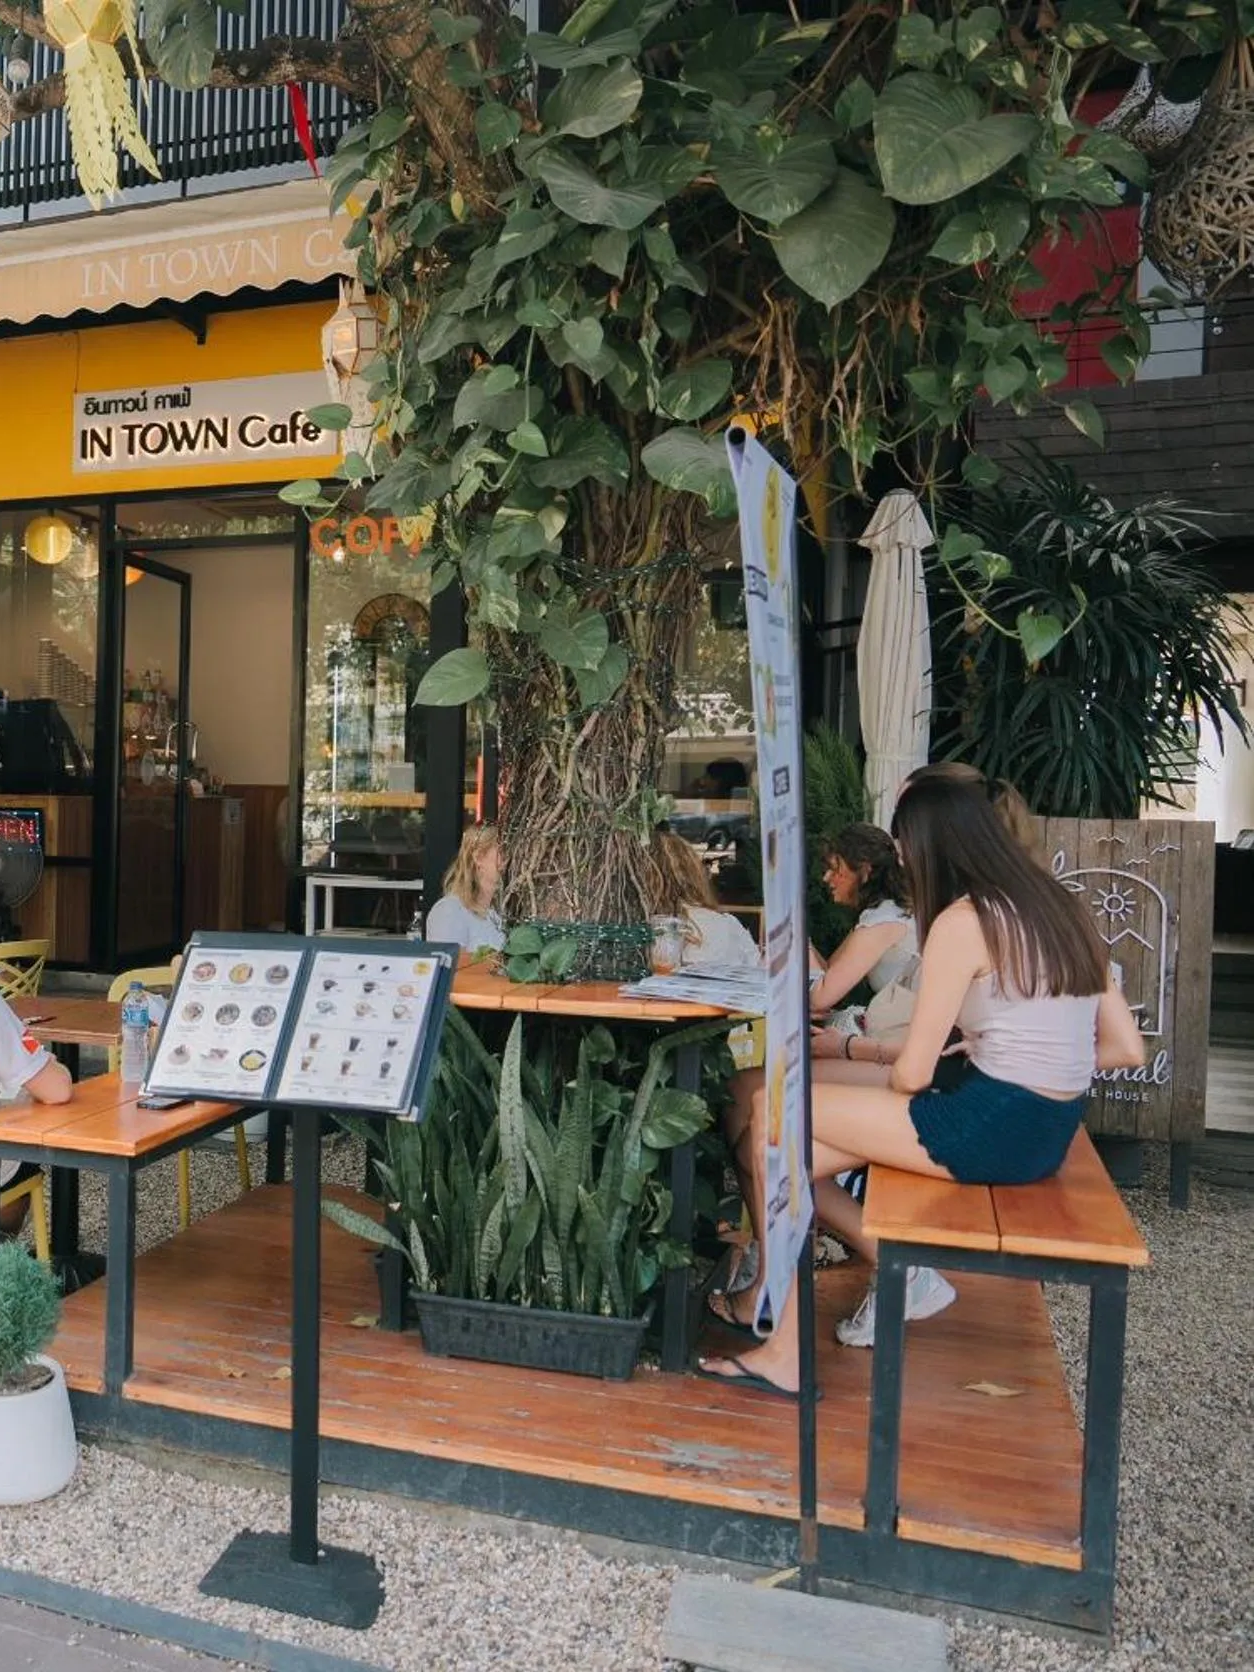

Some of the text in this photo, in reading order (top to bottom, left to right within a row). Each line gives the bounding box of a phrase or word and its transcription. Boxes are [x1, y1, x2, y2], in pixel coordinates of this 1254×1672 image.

[81, 256, 130, 298] IN
[139, 234, 281, 289] TOWN
[83, 389, 148, 416] อินทาวน์
[80, 426, 114, 460] IN
[121, 416, 230, 456] TOWN
[1105, 1087, 1151, 1103] HOUSE
